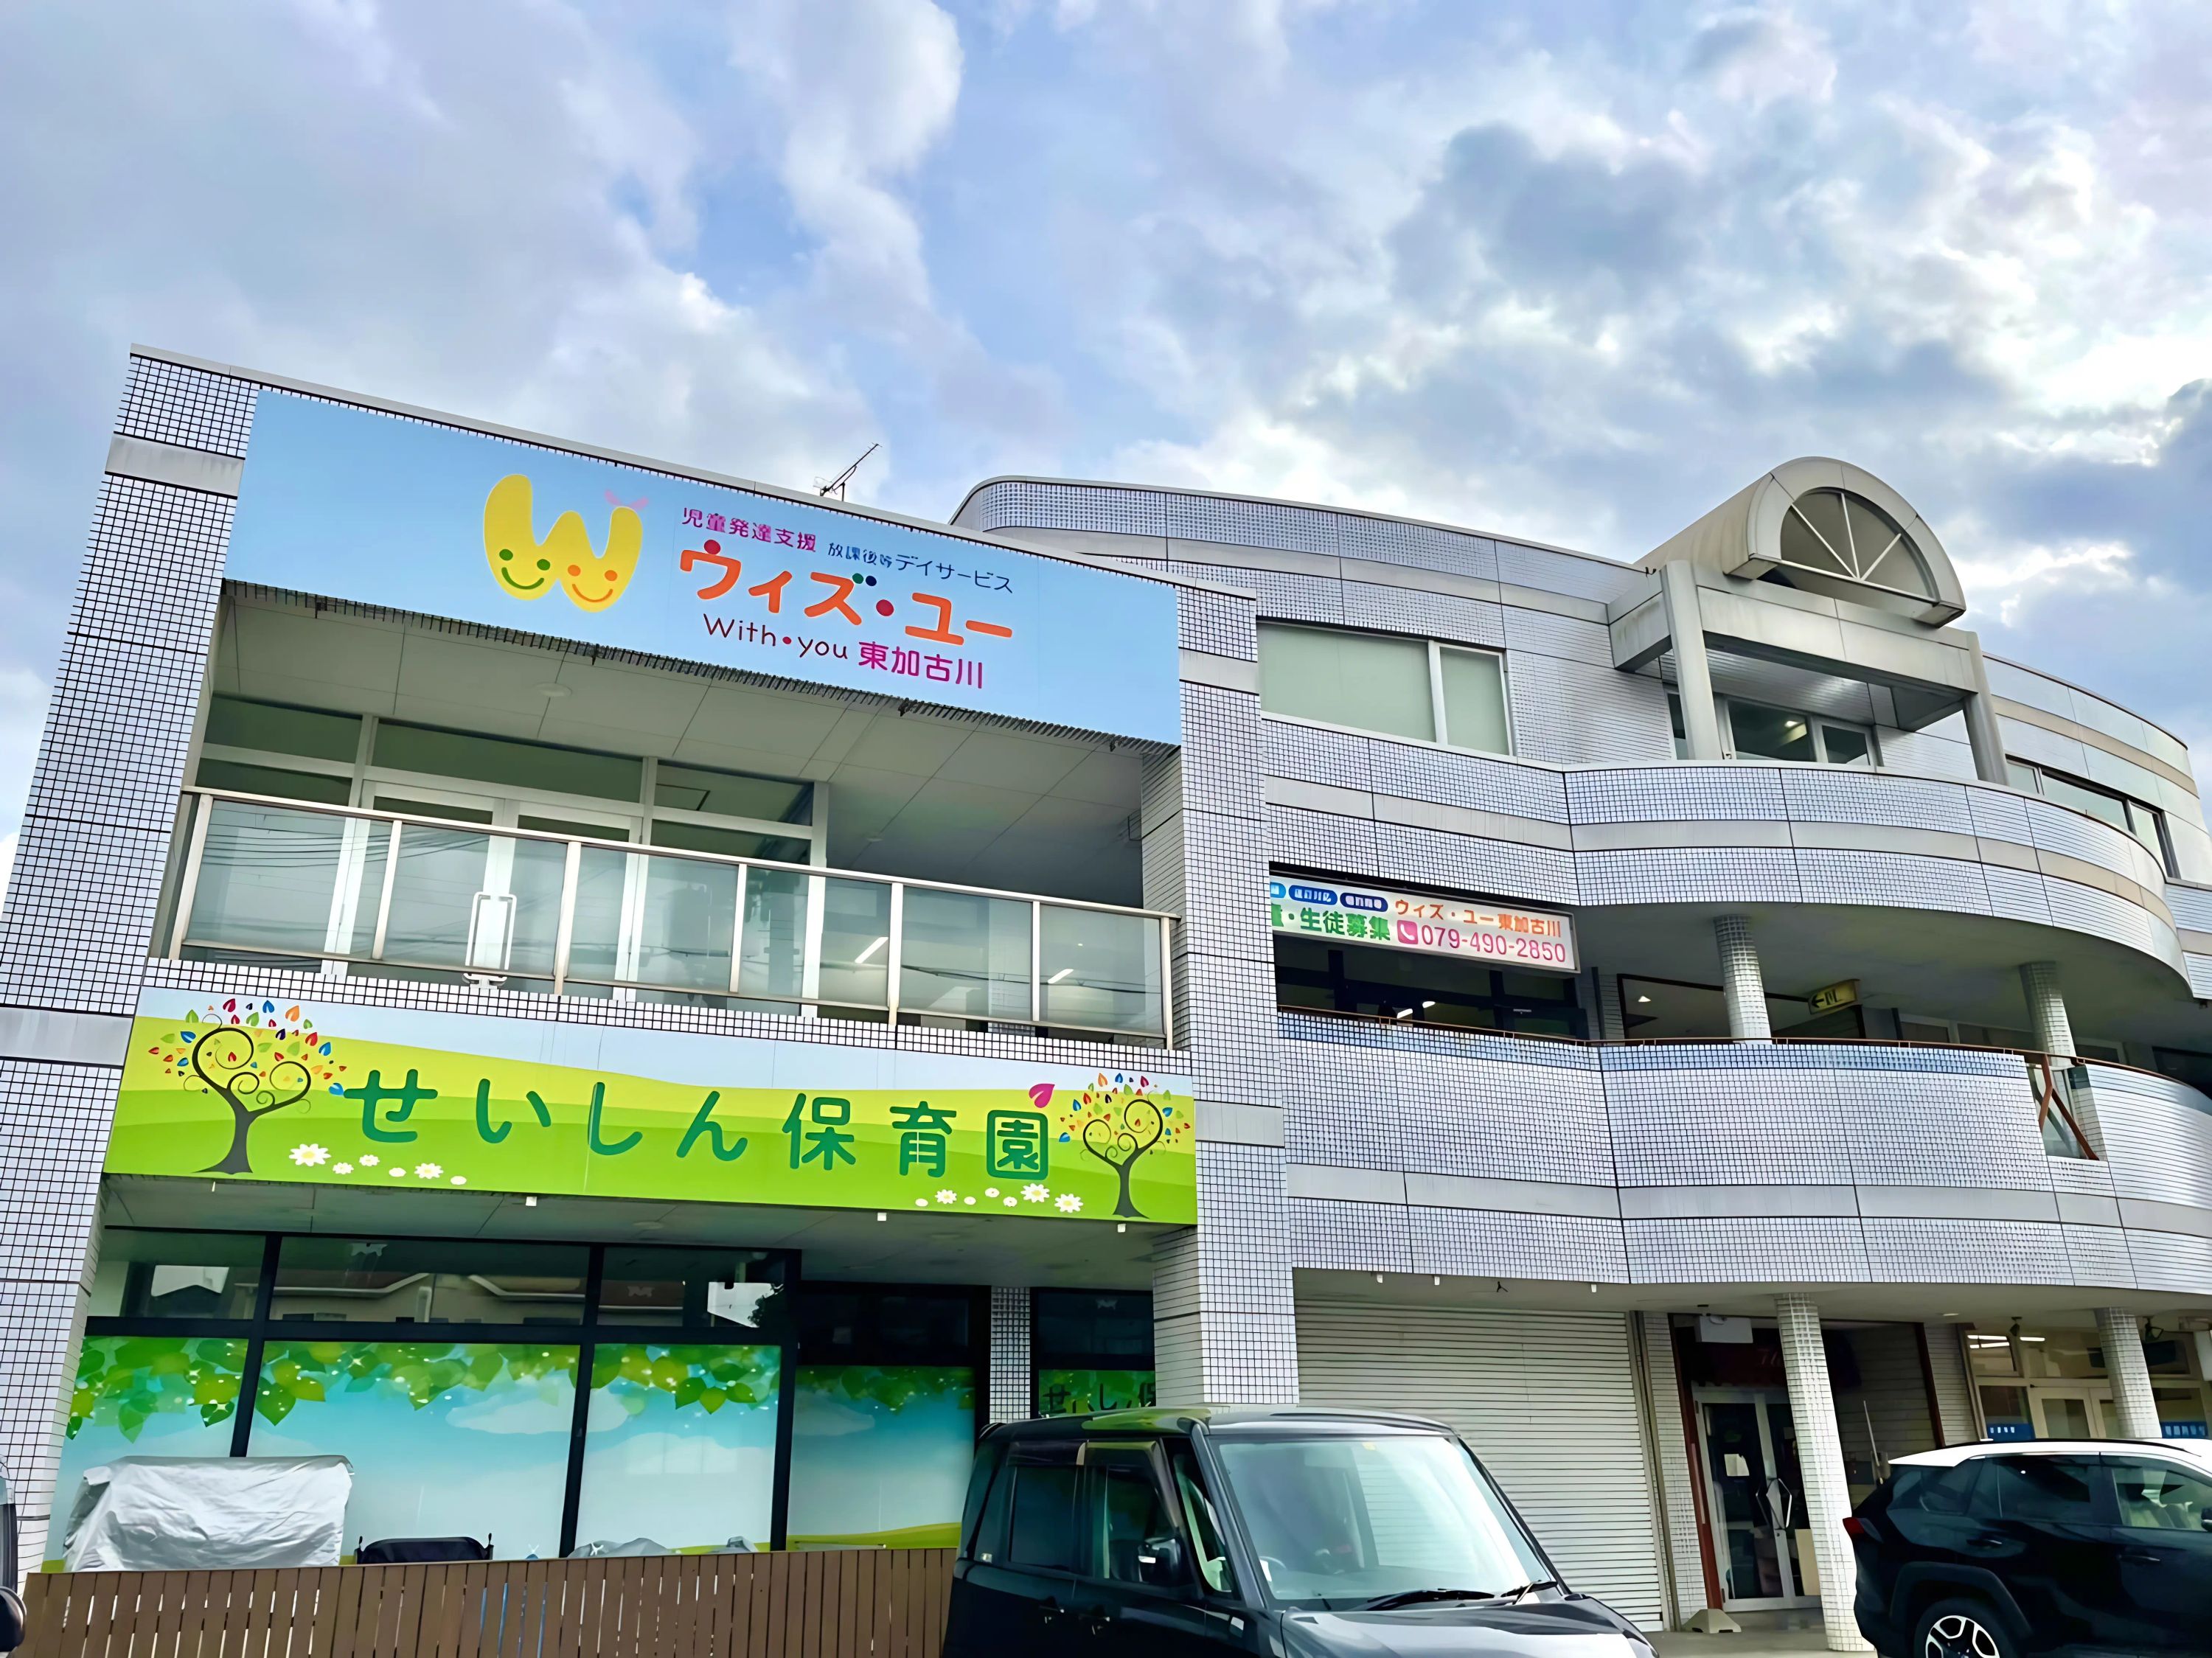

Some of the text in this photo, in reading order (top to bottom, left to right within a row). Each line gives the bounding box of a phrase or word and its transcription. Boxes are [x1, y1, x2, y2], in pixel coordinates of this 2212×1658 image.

[681, 506, 816, 553] 児童発達支援
[858, 641, 984, 689] 東加古川
[1421, 924, 1566, 963] 079-490-2850
[343, 1068, 1049, 1181] せいしん保育園
